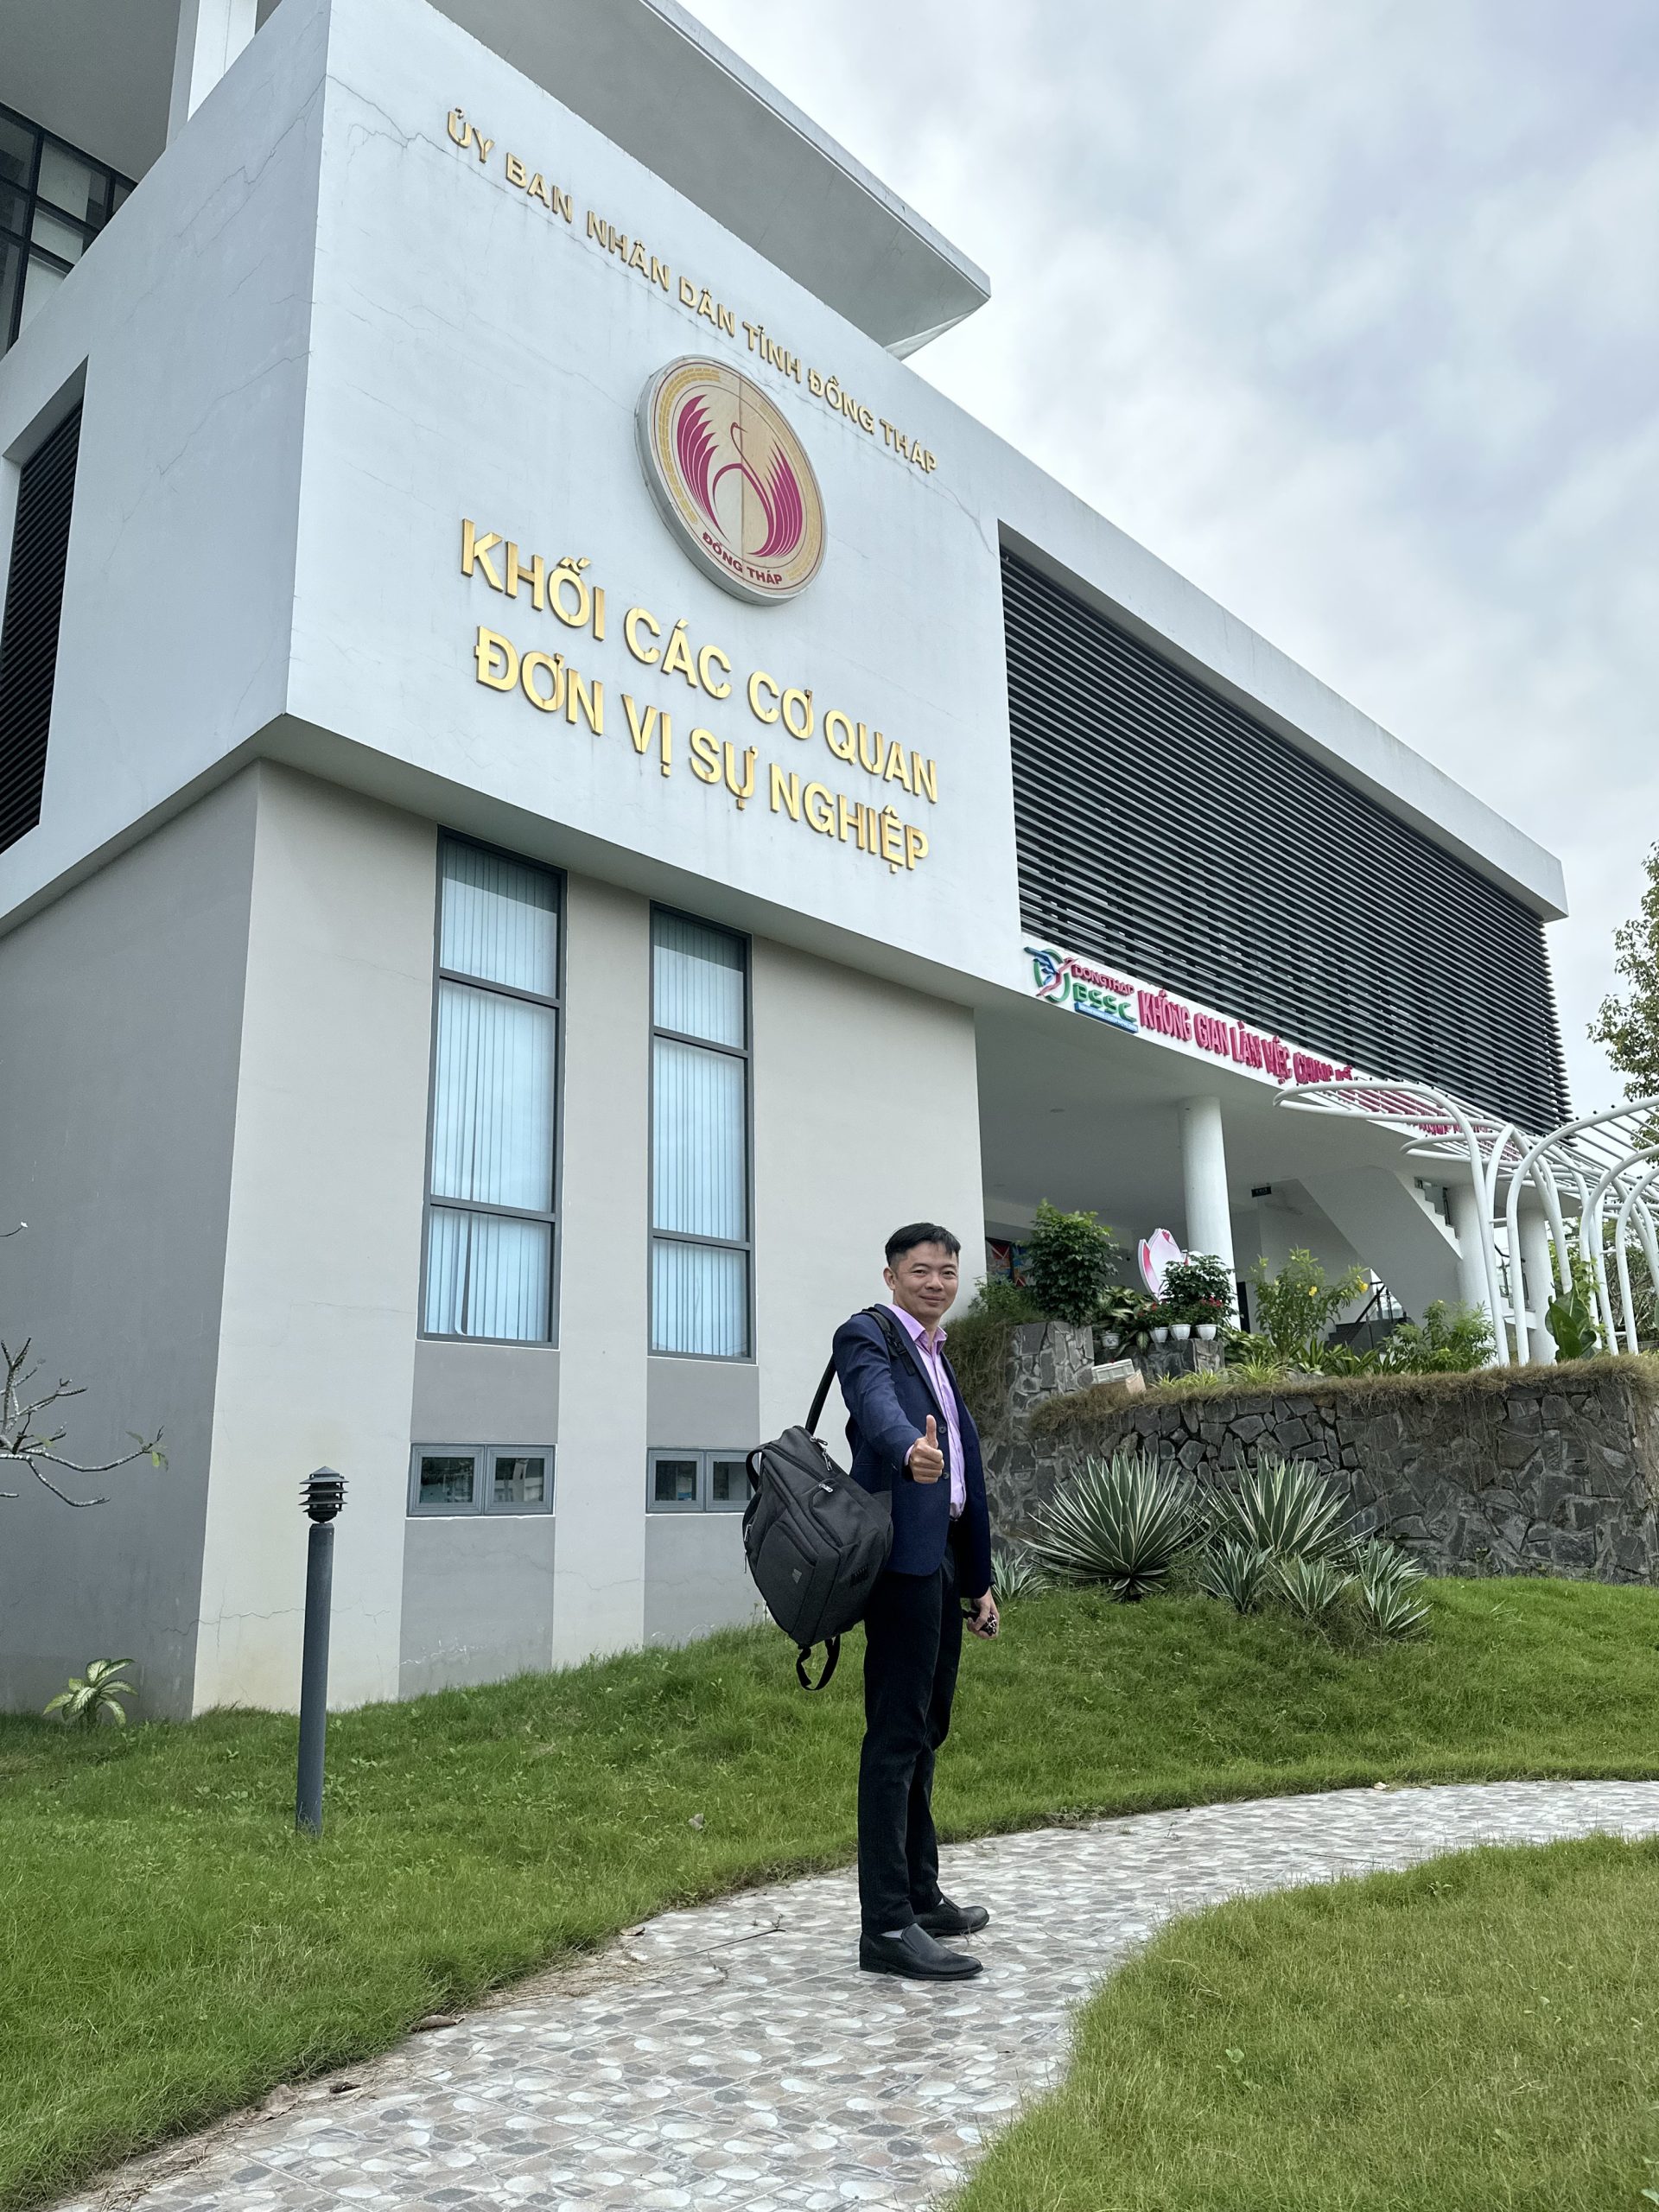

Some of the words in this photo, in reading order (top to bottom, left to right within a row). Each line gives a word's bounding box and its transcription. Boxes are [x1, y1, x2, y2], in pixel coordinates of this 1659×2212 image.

[448, 107, 495, 163] ỦY
[505, 150, 574, 223] BAN
[587, 210, 671, 291] NHÂN
[678, 275, 736, 337] DÂN
[742, 321, 802, 383] TỈNH
[808, 367, 875, 435] ĐỒNG
[879, 417, 938, 474] THÁP
[702, 531, 743, 574] ĐỒNG
[746, 566, 783, 585] THÁP
[461, 518, 605, 641] KHỐI
[624, 606, 732, 700] CÁC
[748, 671, 814, 740] CƠ
[823, 709, 938, 804] QUAN
[474, 626, 604, 736] ĐƠN
[621, 692, 672, 777] VỊ
[689, 727, 759, 810] SỰ
[770, 762, 930, 874] NGHIỆP
[1072, 982, 1137, 1023] BSSC
[1137, 988, 1192, 1043] KHÔNG
[1193, 1012, 1230, 1057] GIAN
[1229, 1020, 1263, 1069] LÀM
[1261, 1036, 1294, 1085] VIỆC
